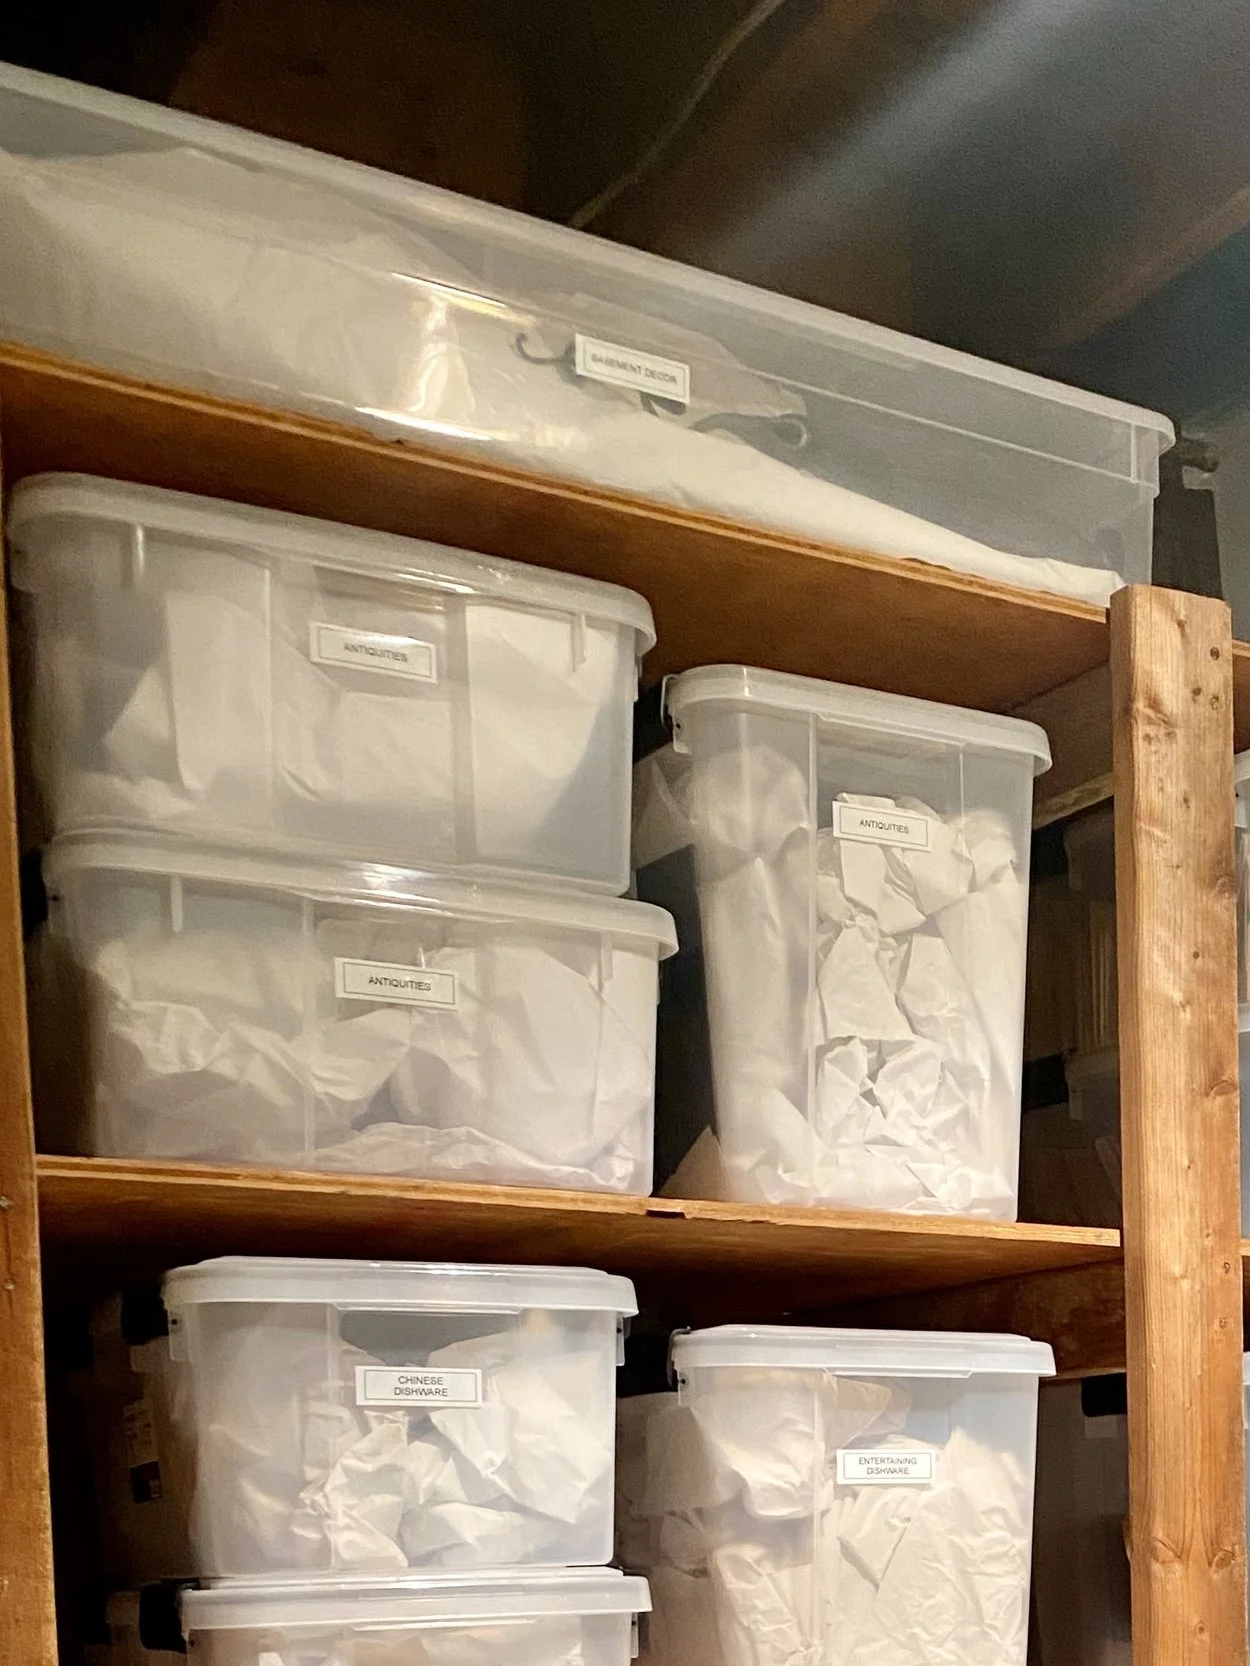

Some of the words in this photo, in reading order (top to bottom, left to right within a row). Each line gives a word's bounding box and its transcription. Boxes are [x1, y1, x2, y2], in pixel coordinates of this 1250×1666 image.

[590, 352, 641, 376] BASEMENT
[644, 366, 678, 384] DECOR
[343, 642, 409, 663] ANTIQUITIES
[859, 818, 909, 834] ANTIQUITIES
[367, 975, 432, 992] ANTIQUITIES
[398, 1375, 444, 1386] CHINESE
[394, 1387, 449, 1397] DISHWARE
[858, 1457, 918, 1466] ENTERTAINING
[866, 1466, 910, 1476] DISHWARE
